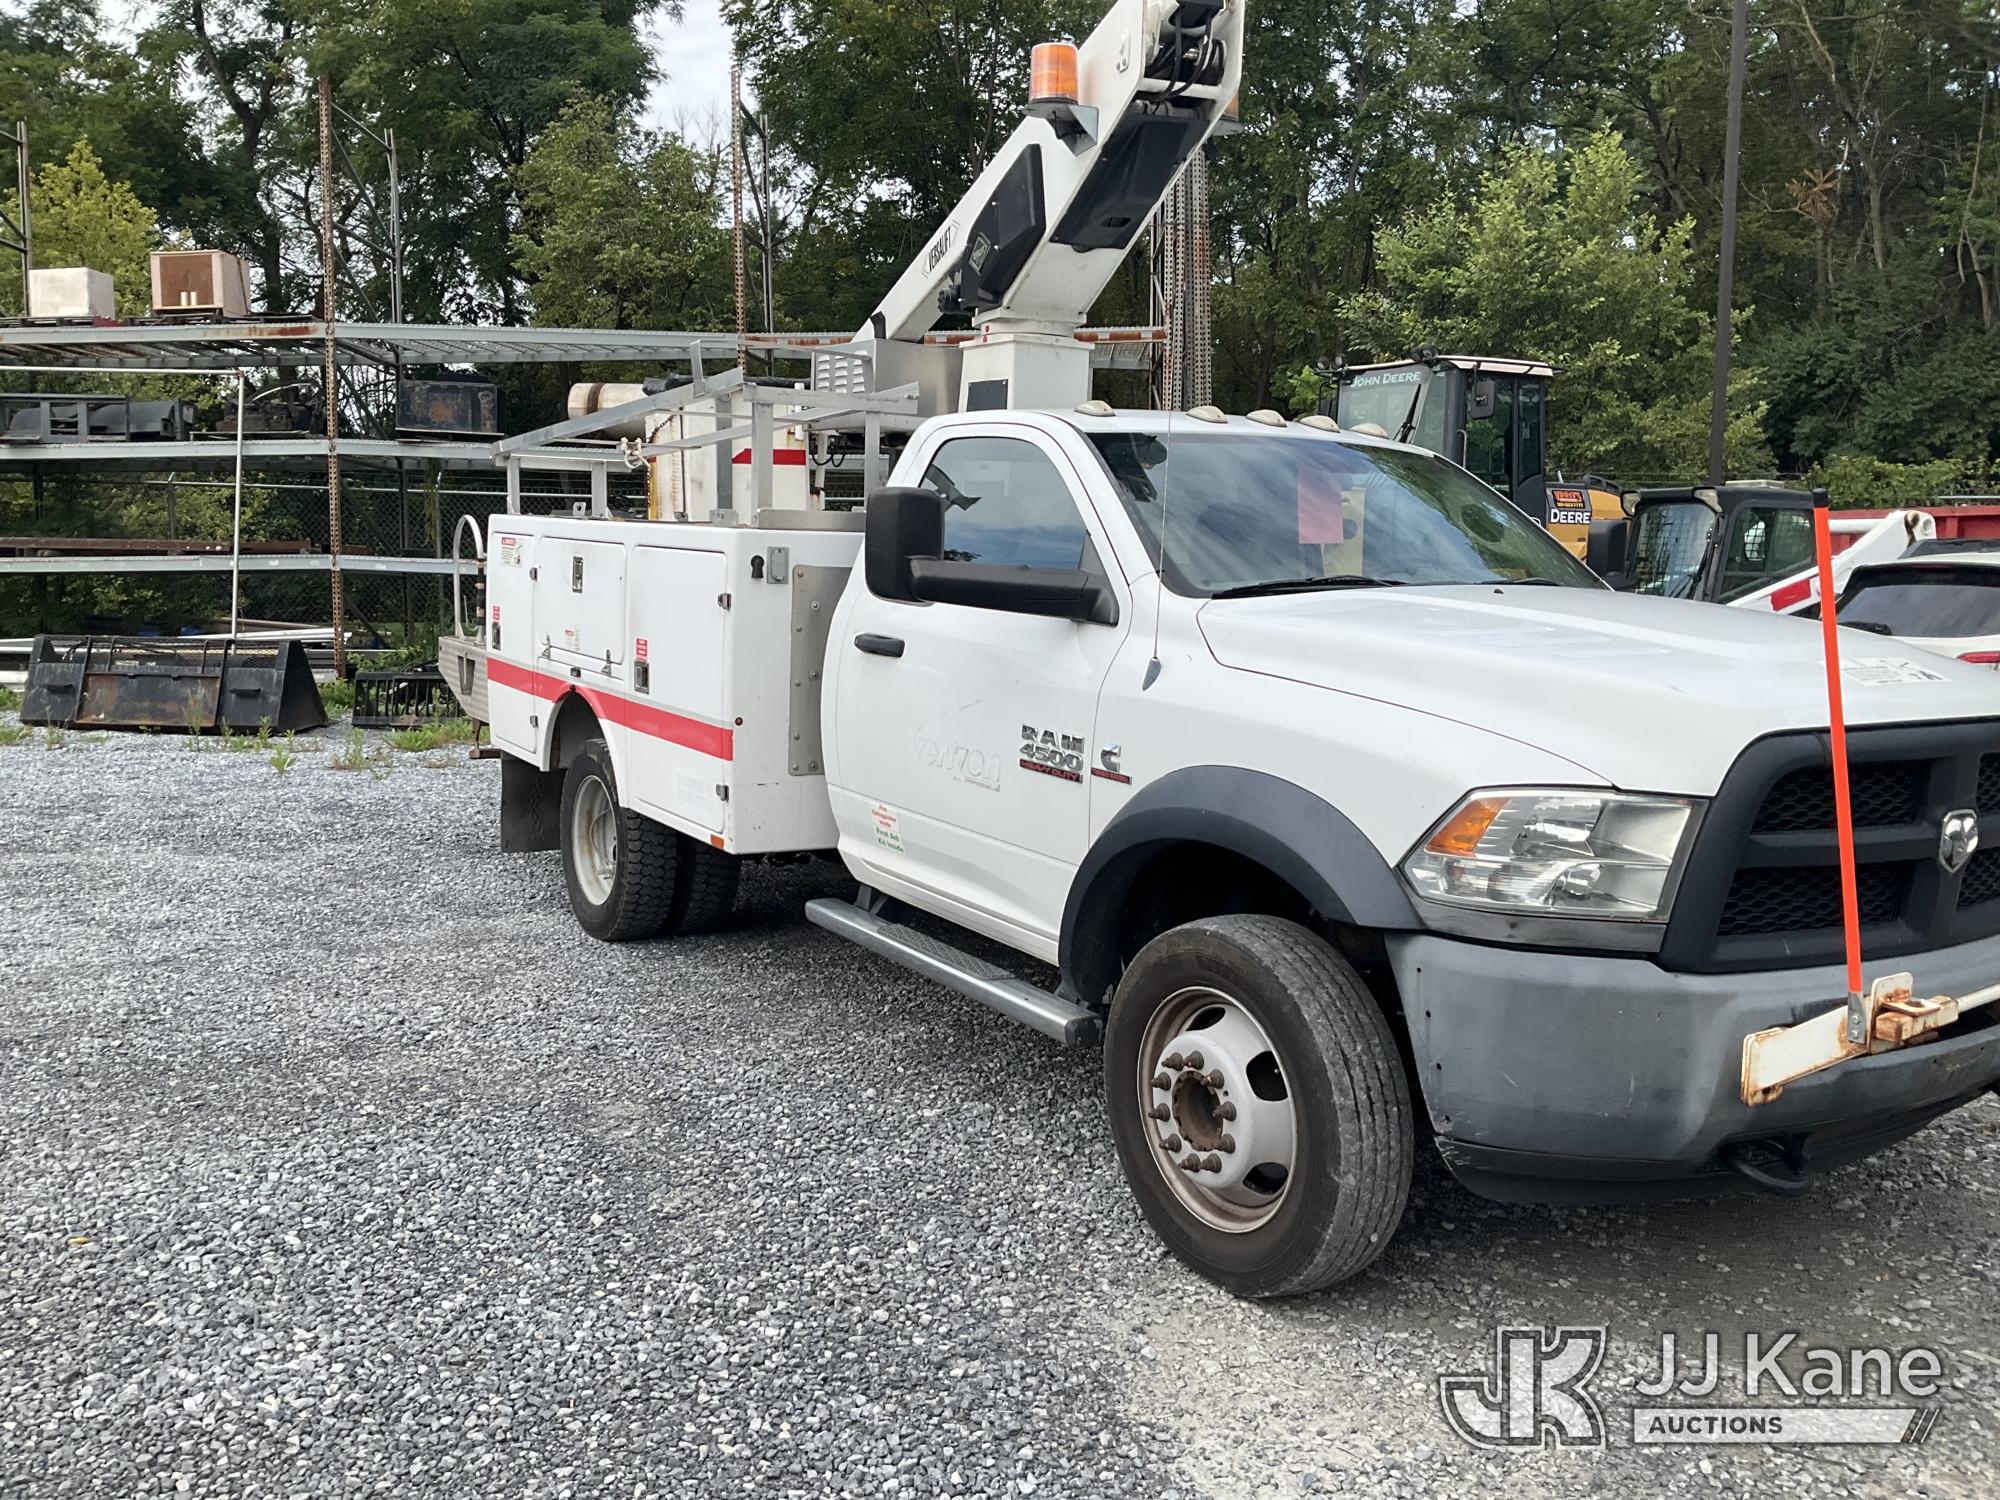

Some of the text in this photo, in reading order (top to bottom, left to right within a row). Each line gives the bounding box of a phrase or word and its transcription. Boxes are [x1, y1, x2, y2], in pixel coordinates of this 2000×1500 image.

[1350, 371, 1422, 388] JOHN DEERE
[1550, 508, 1591, 524] DEERE
[1021, 723, 1085, 754] RAM
[1019, 742, 1084, 771] 4500
[1050, 767, 1080, 781] DUTY
